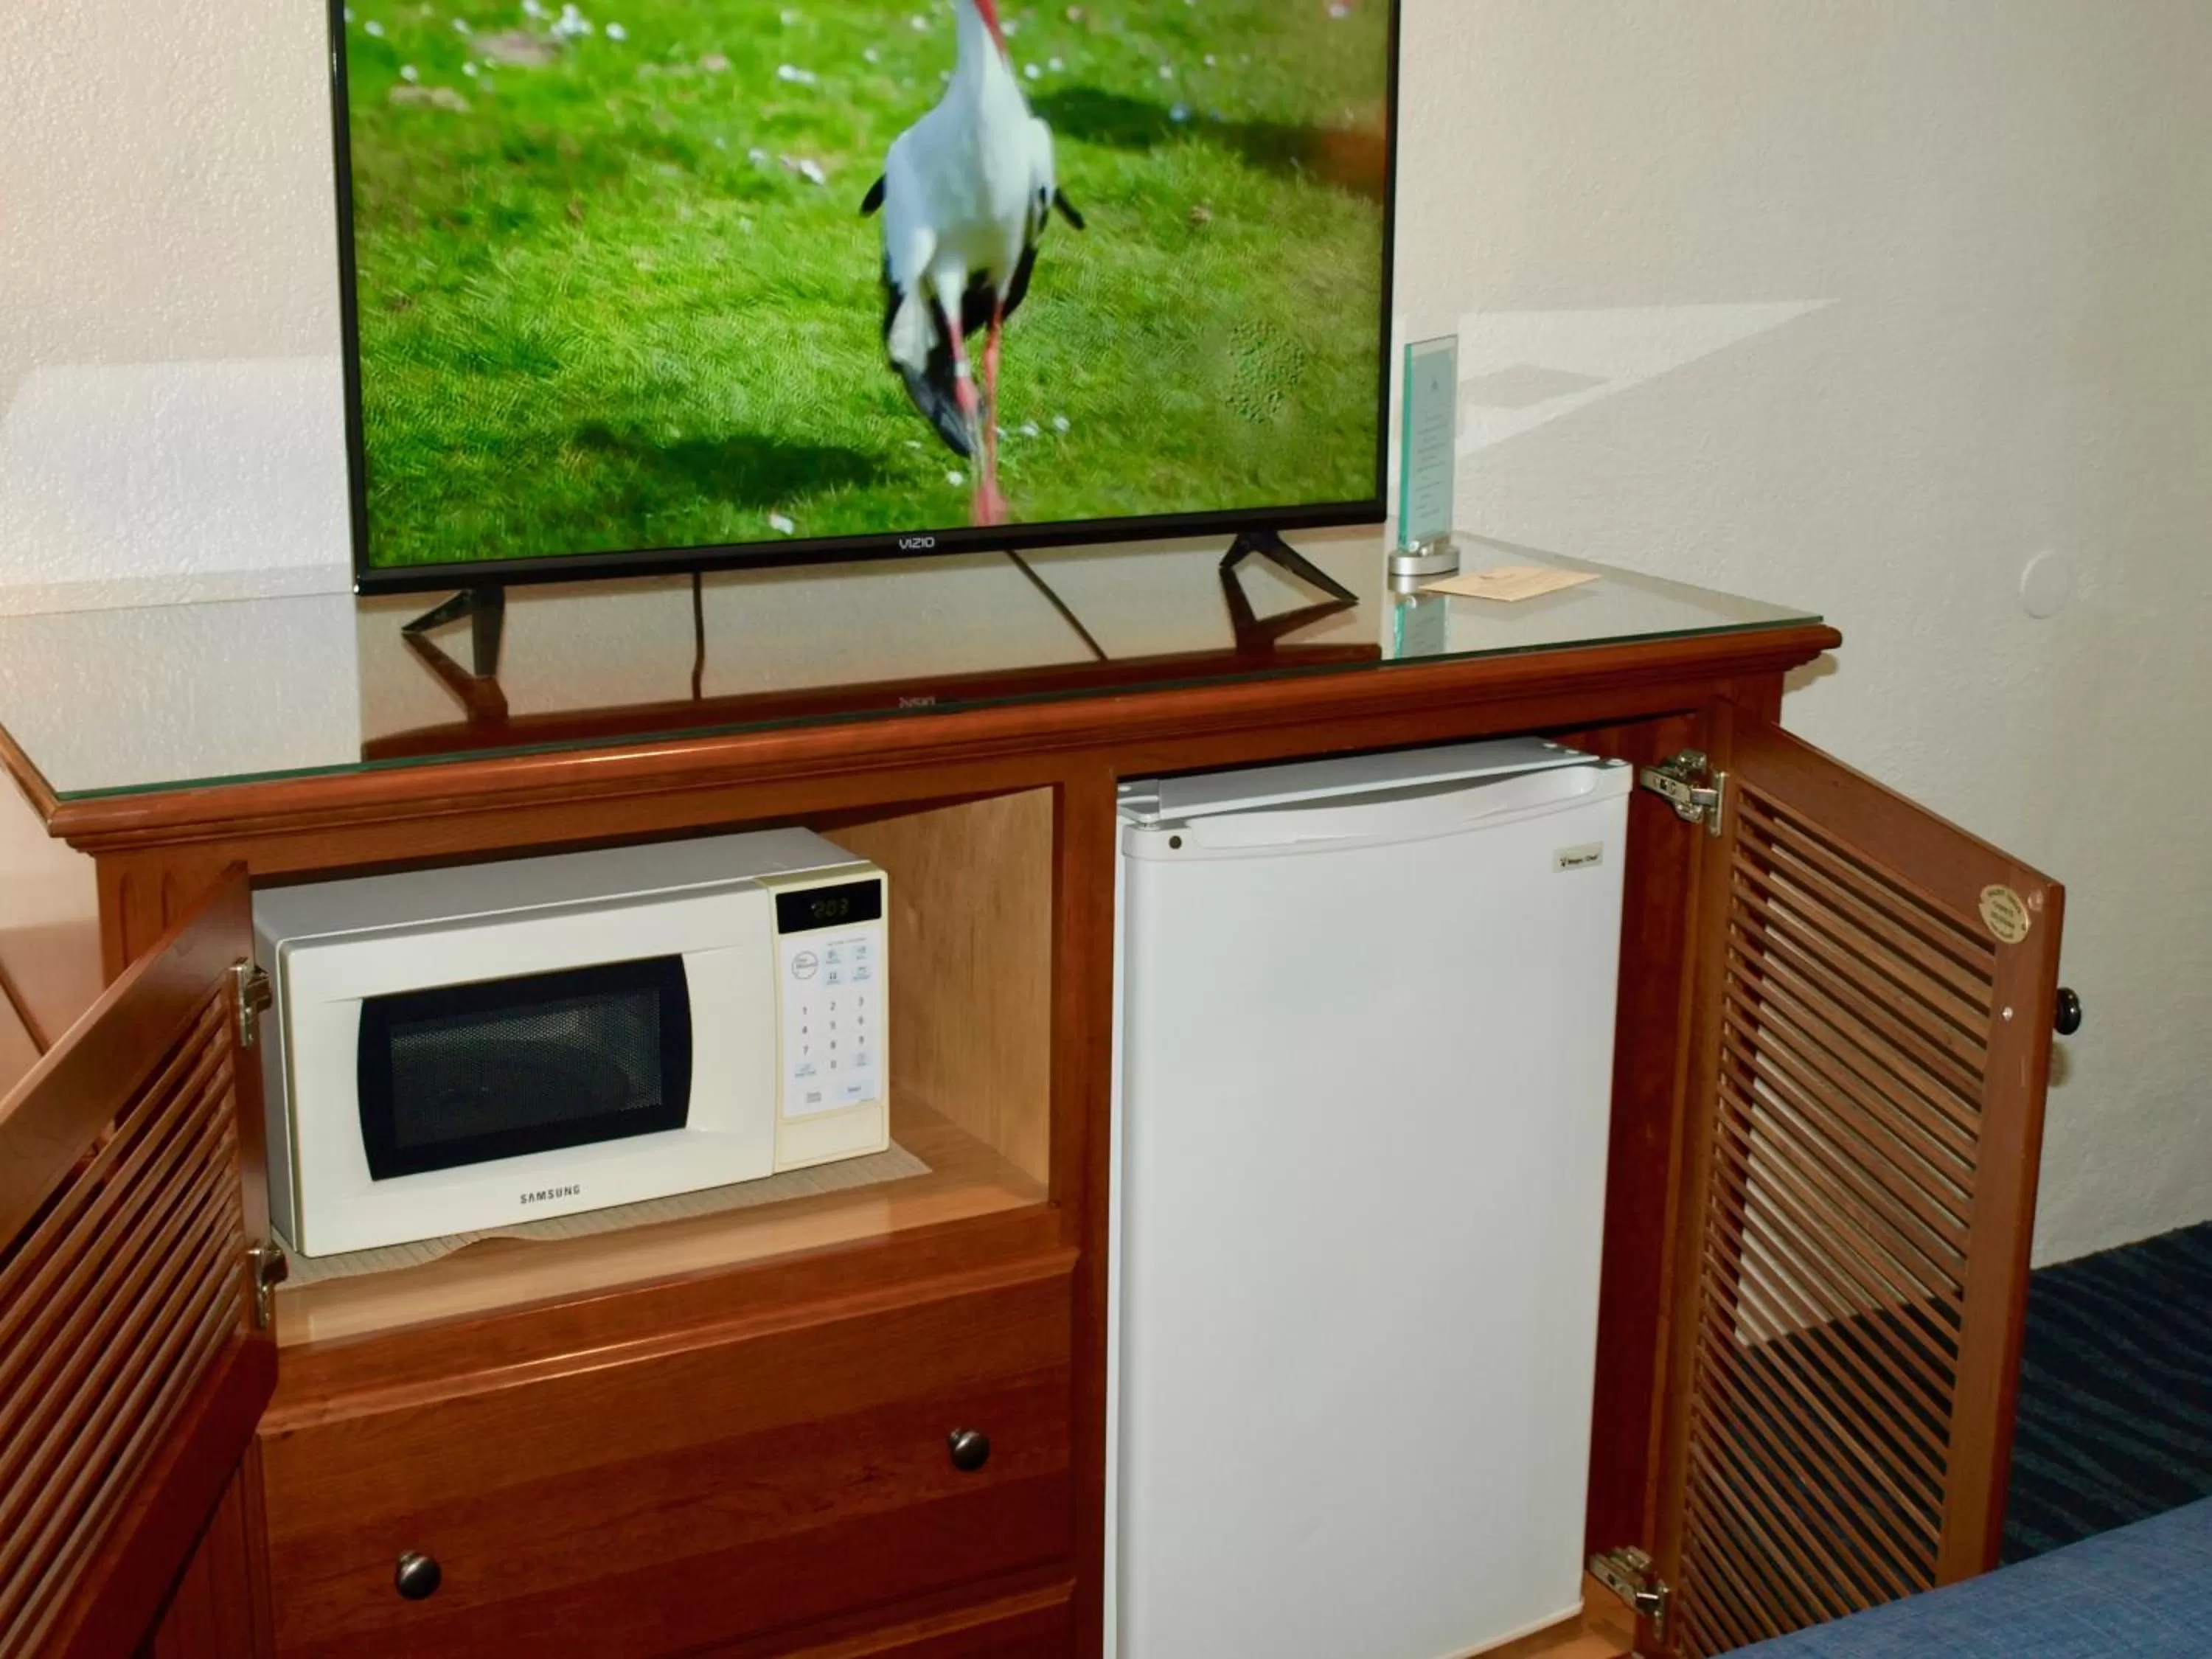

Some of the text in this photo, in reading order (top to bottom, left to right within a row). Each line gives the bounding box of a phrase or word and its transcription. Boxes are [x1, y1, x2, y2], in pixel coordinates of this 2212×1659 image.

[898, 536, 936, 550] VIZIO
[830, 1001, 836, 1012] 2
[802, 1044, 810, 1056] 7
[520, 1183, 581, 1204] SAMSUNG
